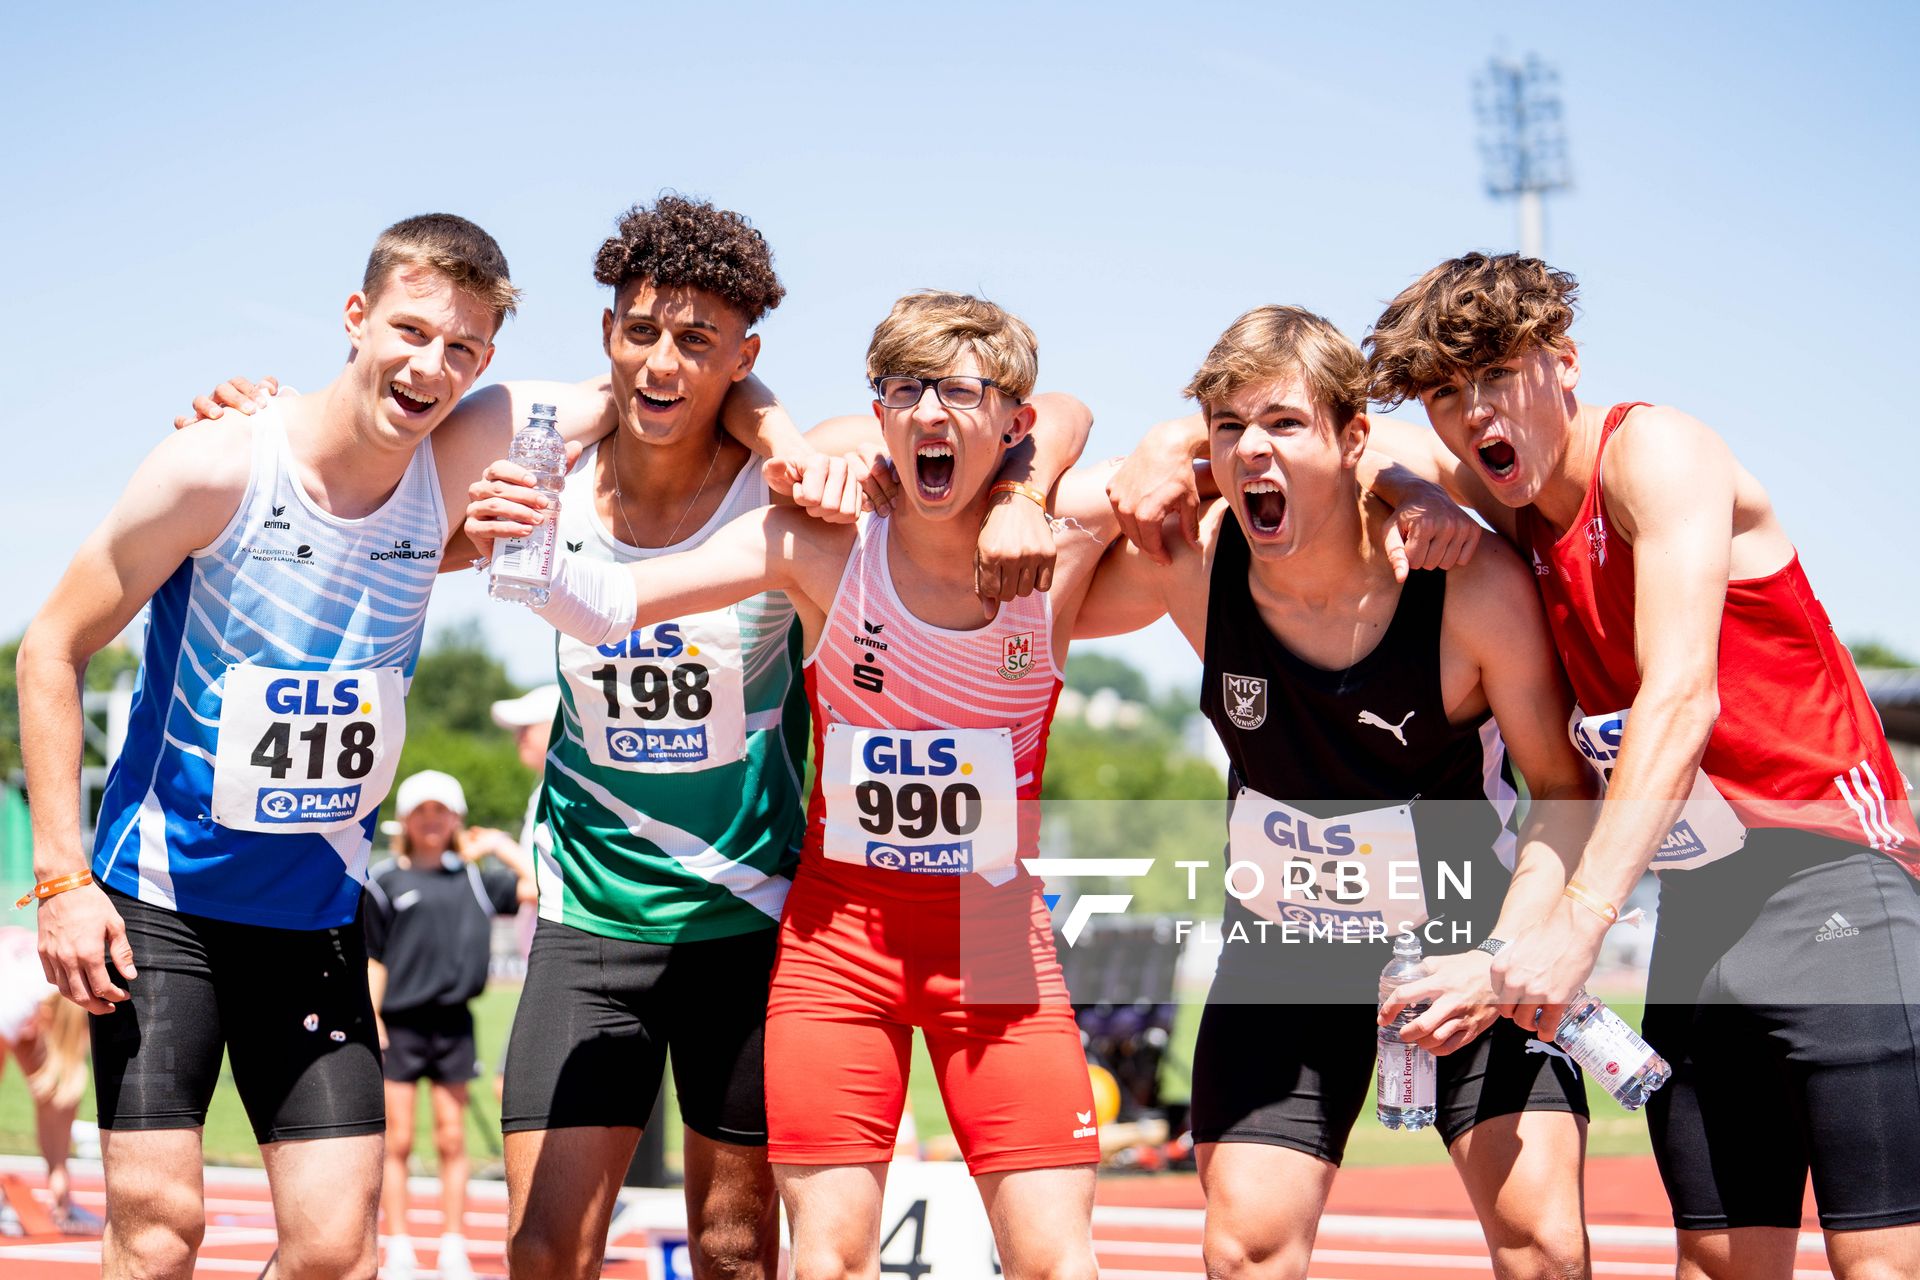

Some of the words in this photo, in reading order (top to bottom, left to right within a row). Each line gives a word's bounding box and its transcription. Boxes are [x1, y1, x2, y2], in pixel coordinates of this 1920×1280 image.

[263, 520, 291, 530] erima
[394, 540, 411, 549] LG
[370, 549, 437, 561] DORNBURG
[541, 548, 551, 576] Black
[853, 635, 888, 651] erima
[1007, 653, 1029, 671] SC
[592, 662, 713, 721] 198
[1228, 676, 1262, 695] MTG
[1229, 709, 1263, 727] MANNHEIM
[250, 721, 376, 780] 418
[646, 733, 703, 750] PLAN
[647, 751, 704, 759] INTERNATIONAL
[301, 792, 357, 810] PLAN
[855, 780, 982, 839] 990
[300, 810, 353, 819] INTERNATIONAL
[909, 848, 969, 866] PLAN
[1815, 927, 1860, 943] adidas
[1403, 1048, 1412, 1076] Forest
[1403, 1078, 1412, 1104] Black
[1072, 1126, 1097, 1139] erima
